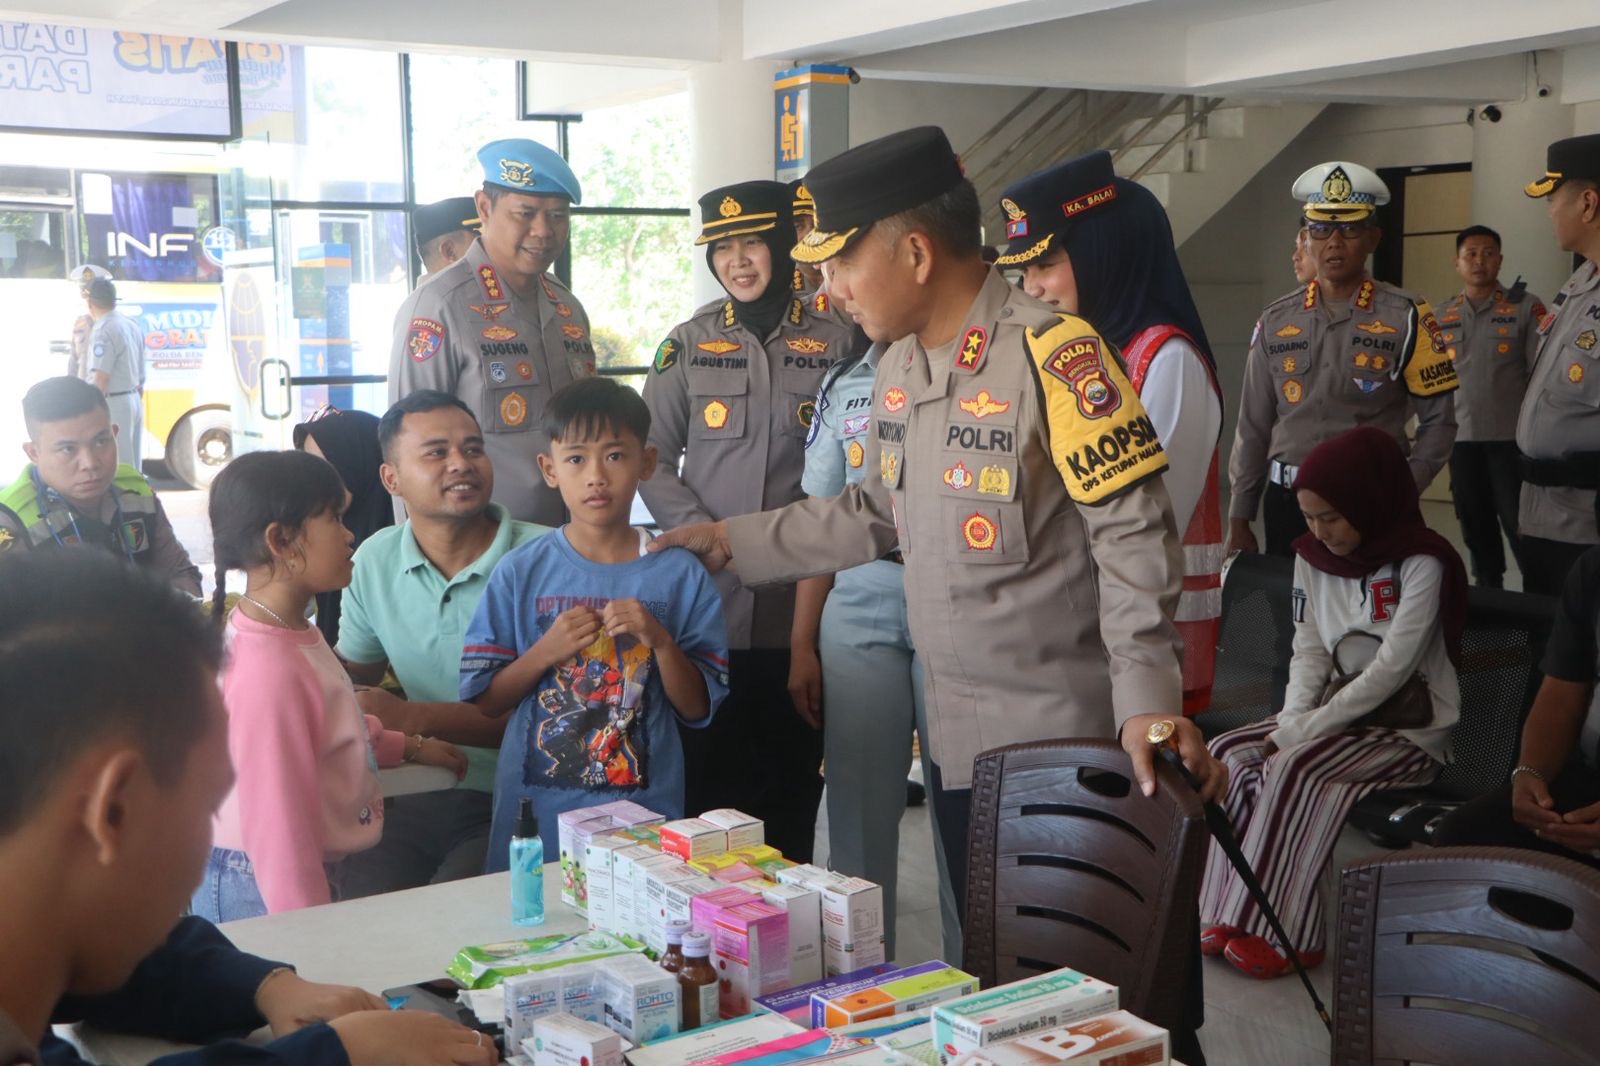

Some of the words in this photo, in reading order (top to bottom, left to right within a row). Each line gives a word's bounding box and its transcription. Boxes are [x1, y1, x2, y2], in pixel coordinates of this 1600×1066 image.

[1066, 203, 1085, 214] KA.
[1087, 189, 1114, 206] BALAI
[413, 319, 443, 333] PROPAM
[480, 342, 529, 357] SUGENG
[1352, 336, 1396, 352] POLRI
[690, 355, 748, 369] AGUSTINI
[1054, 343, 1095, 370] POLDA
[946, 425, 1013, 453] POLRI
[1081, 477, 1101, 492] OPS
[1100, 455, 1139, 483] KETUPAT
[636, 991, 674, 1008] ROHTO
[1018, 1019, 1040, 1035] Sodium
[1048, 1015, 1057, 1027] mg
[1014, 1028, 1097, 1060] B
